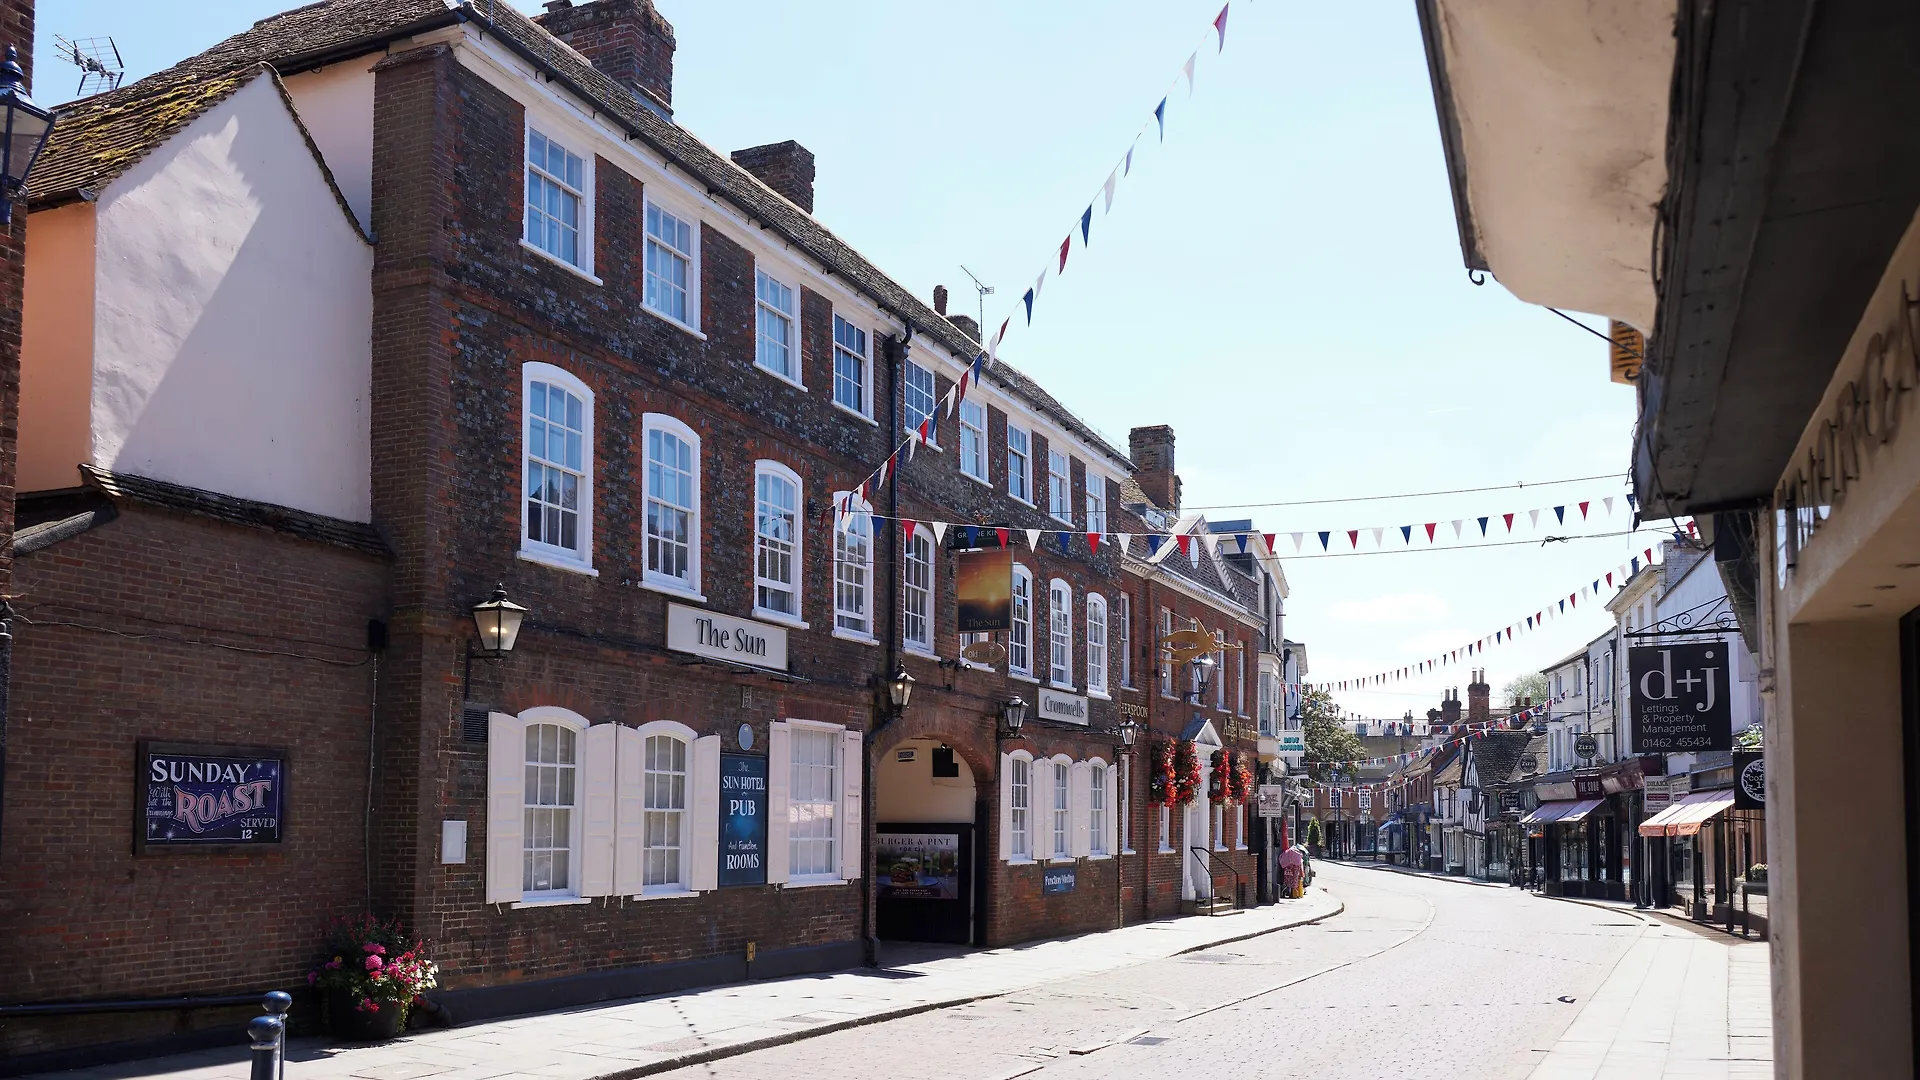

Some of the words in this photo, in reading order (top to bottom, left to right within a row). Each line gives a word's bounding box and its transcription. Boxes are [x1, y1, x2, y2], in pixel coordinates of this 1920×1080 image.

[967, 619, 983, 627] The
[984, 619, 1000, 627] Sun
[696, 618, 730, 649] The
[734, 627, 767, 657] Sun
[1044, 695, 1085, 719] Cromwells
[1641, 704, 1679, 714] Lettings
[1642, 714, 1650, 724] &
[1653, 714, 1695, 724] Property
[1642, 723, 1707, 735] Management
[1642, 738, 1672, 748] 01462
[1675, 737, 1712, 747] 455434
[151, 759, 251, 783] SUNDAY
[723, 775, 739, 789] SUN
[741, 776, 766, 790] HOTEL
[172, 780, 272, 834] ROAST
[729, 799, 756, 816] PUB
[240, 817, 276, 828] SERVED
[726, 853, 760, 870] ROOMS
